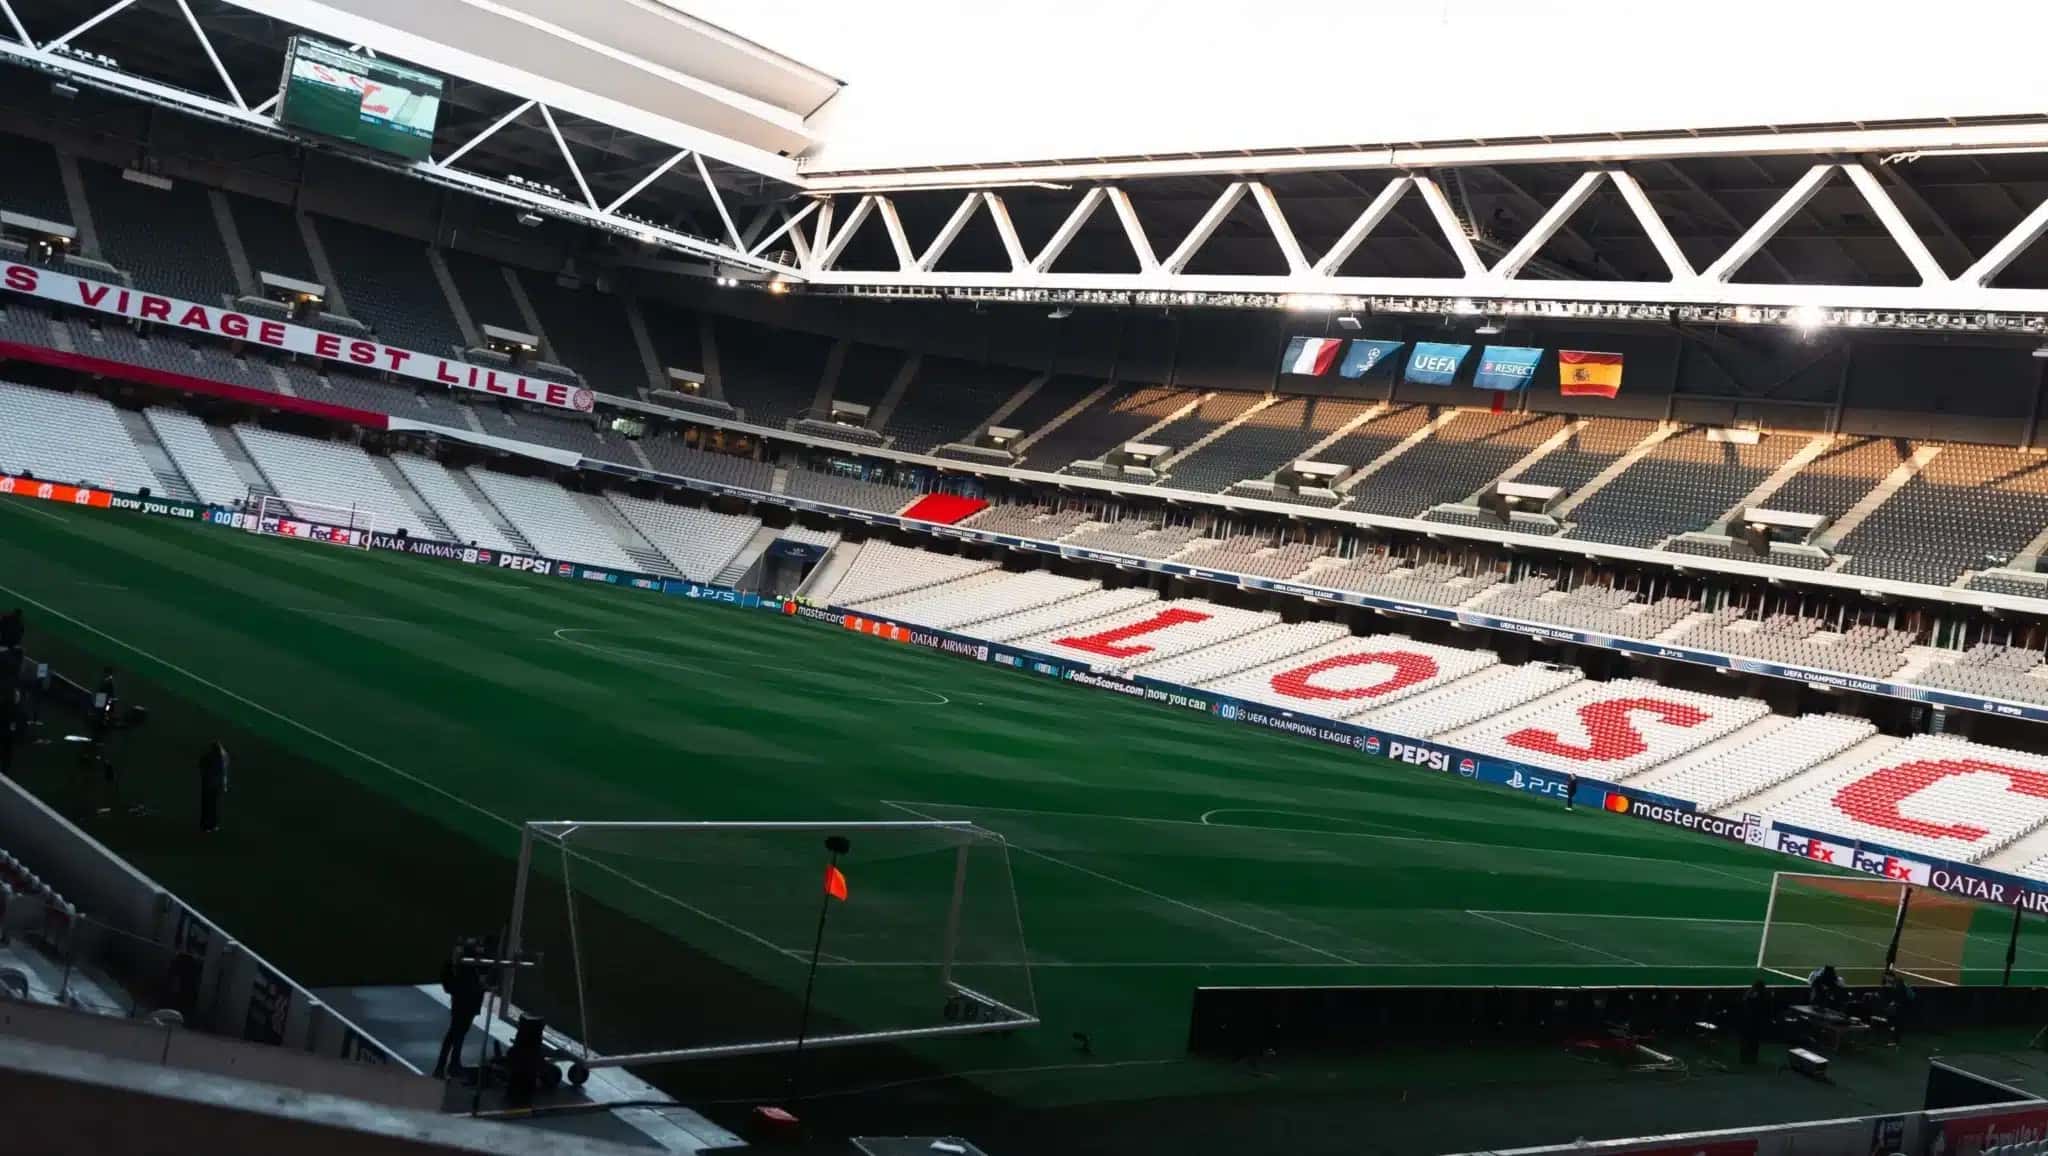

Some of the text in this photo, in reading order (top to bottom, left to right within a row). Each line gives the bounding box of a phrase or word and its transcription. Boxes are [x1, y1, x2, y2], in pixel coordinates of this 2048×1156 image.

[5, 265, 568, 405] S VIRAGE EST LILLE
[1414, 355, 1456, 372] UEFA
[1495, 363, 1537, 376] RESPECT
[112, 496, 194, 518] now you can
[261, 516, 296, 536] edEx
[310, 525, 348, 544] FedEx
[361, 534, 463, 560] QATAR AIRWAYS
[499, 554, 551, 575] PEPSI
[702, 588, 735, 602] PS5
[798, 606, 845, 625] mastercard
[910, 632, 979, 658] QATAR AIRWAYS
[1783, 668, 1877, 691] UEFA CHAMPIONS LEAGUE
[1147, 686, 1206, 711] now you can
[1247, 711, 1351, 746] UEFA CHAMPIONS LEAGUE
[1388, 741, 1449, 772] PEPSI
[1529, 777, 1569, 798] PS5
[1633, 799, 1745, 840] mastercard
[1777, 833, 1834, 863] FedEx
[1852, 849, 1913, 881] FedEx
[1932, 870, 2004, 902] QATAR
